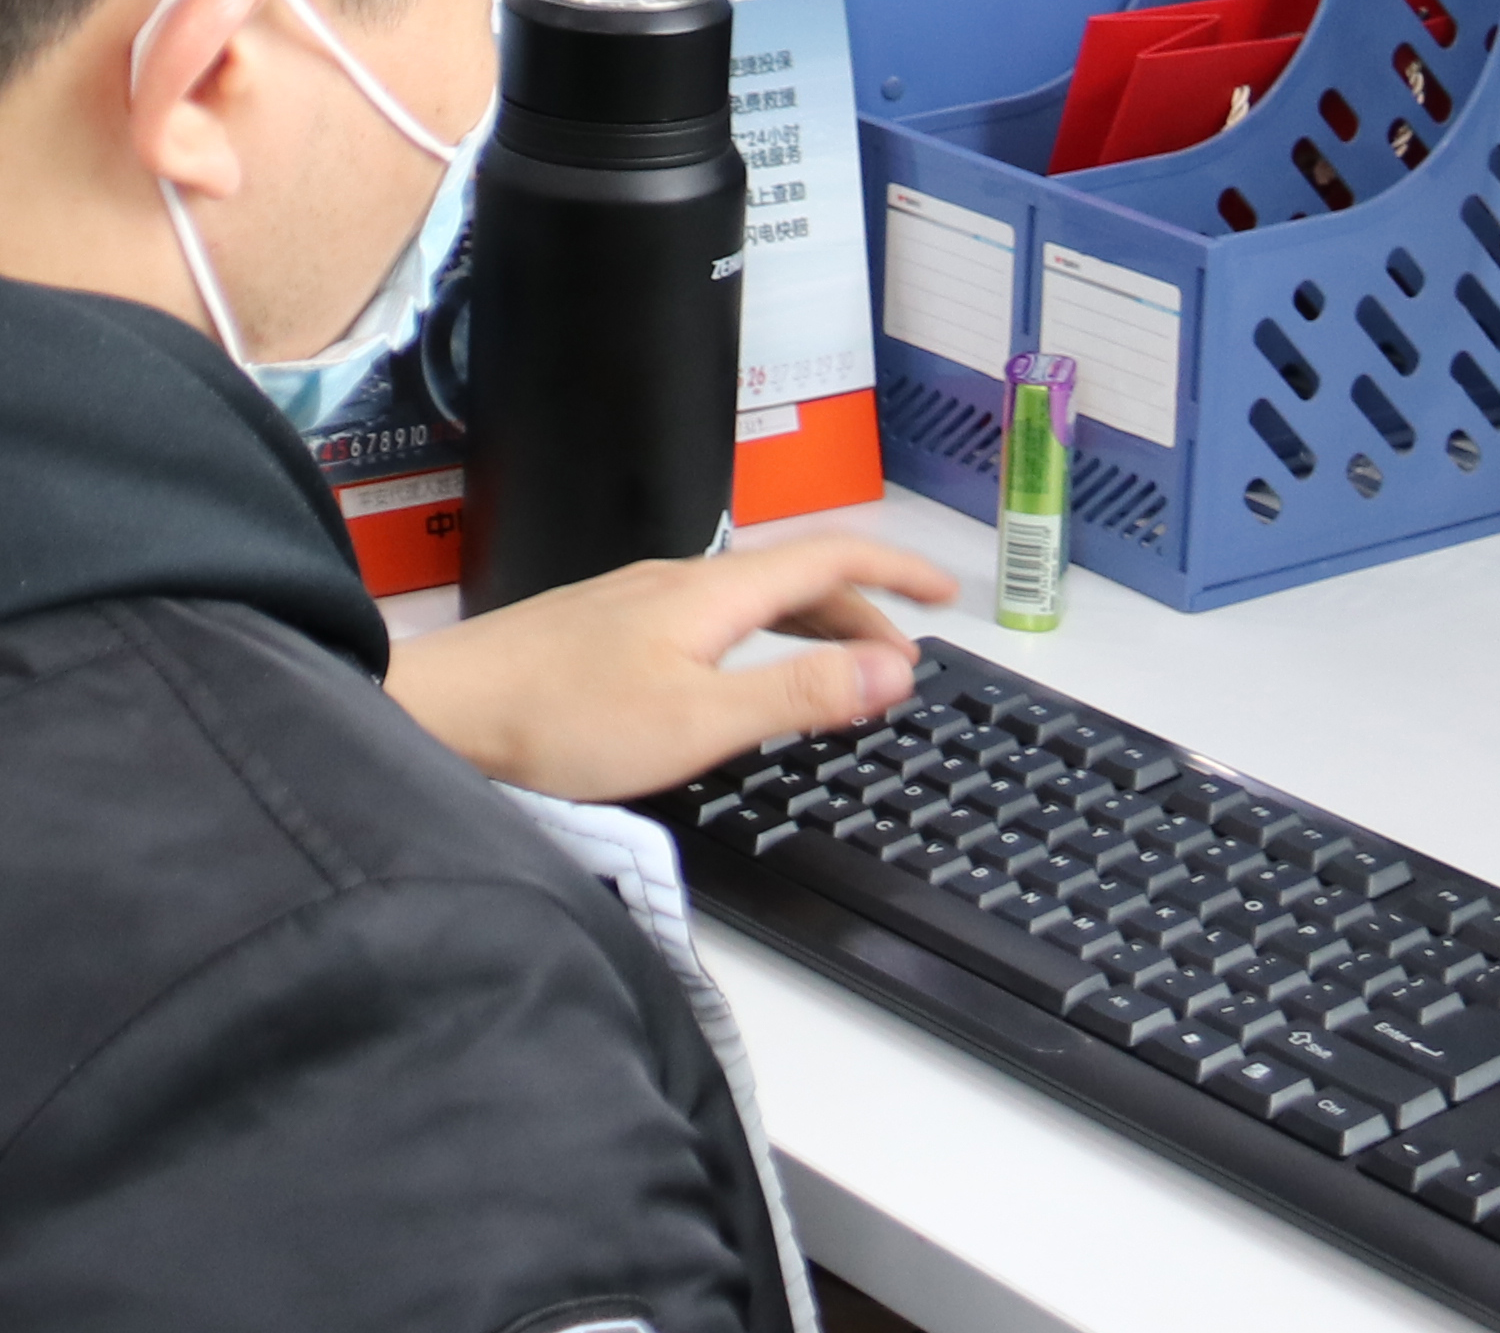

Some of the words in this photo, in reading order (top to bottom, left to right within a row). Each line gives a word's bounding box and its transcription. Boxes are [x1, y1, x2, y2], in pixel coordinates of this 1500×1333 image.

[746, 364, 767, 388] 26
[350, 436, 362, 458] 6
[366, 433, 378, 454] 7
[379, 430, 391, 453] 8
[394, 428, 406, 450] 9
[409, 424, 428, 446] 10
[1373, 1021, 1411, 1044] Enter
[1316, 1098, 1347, 1117] Ctrl
